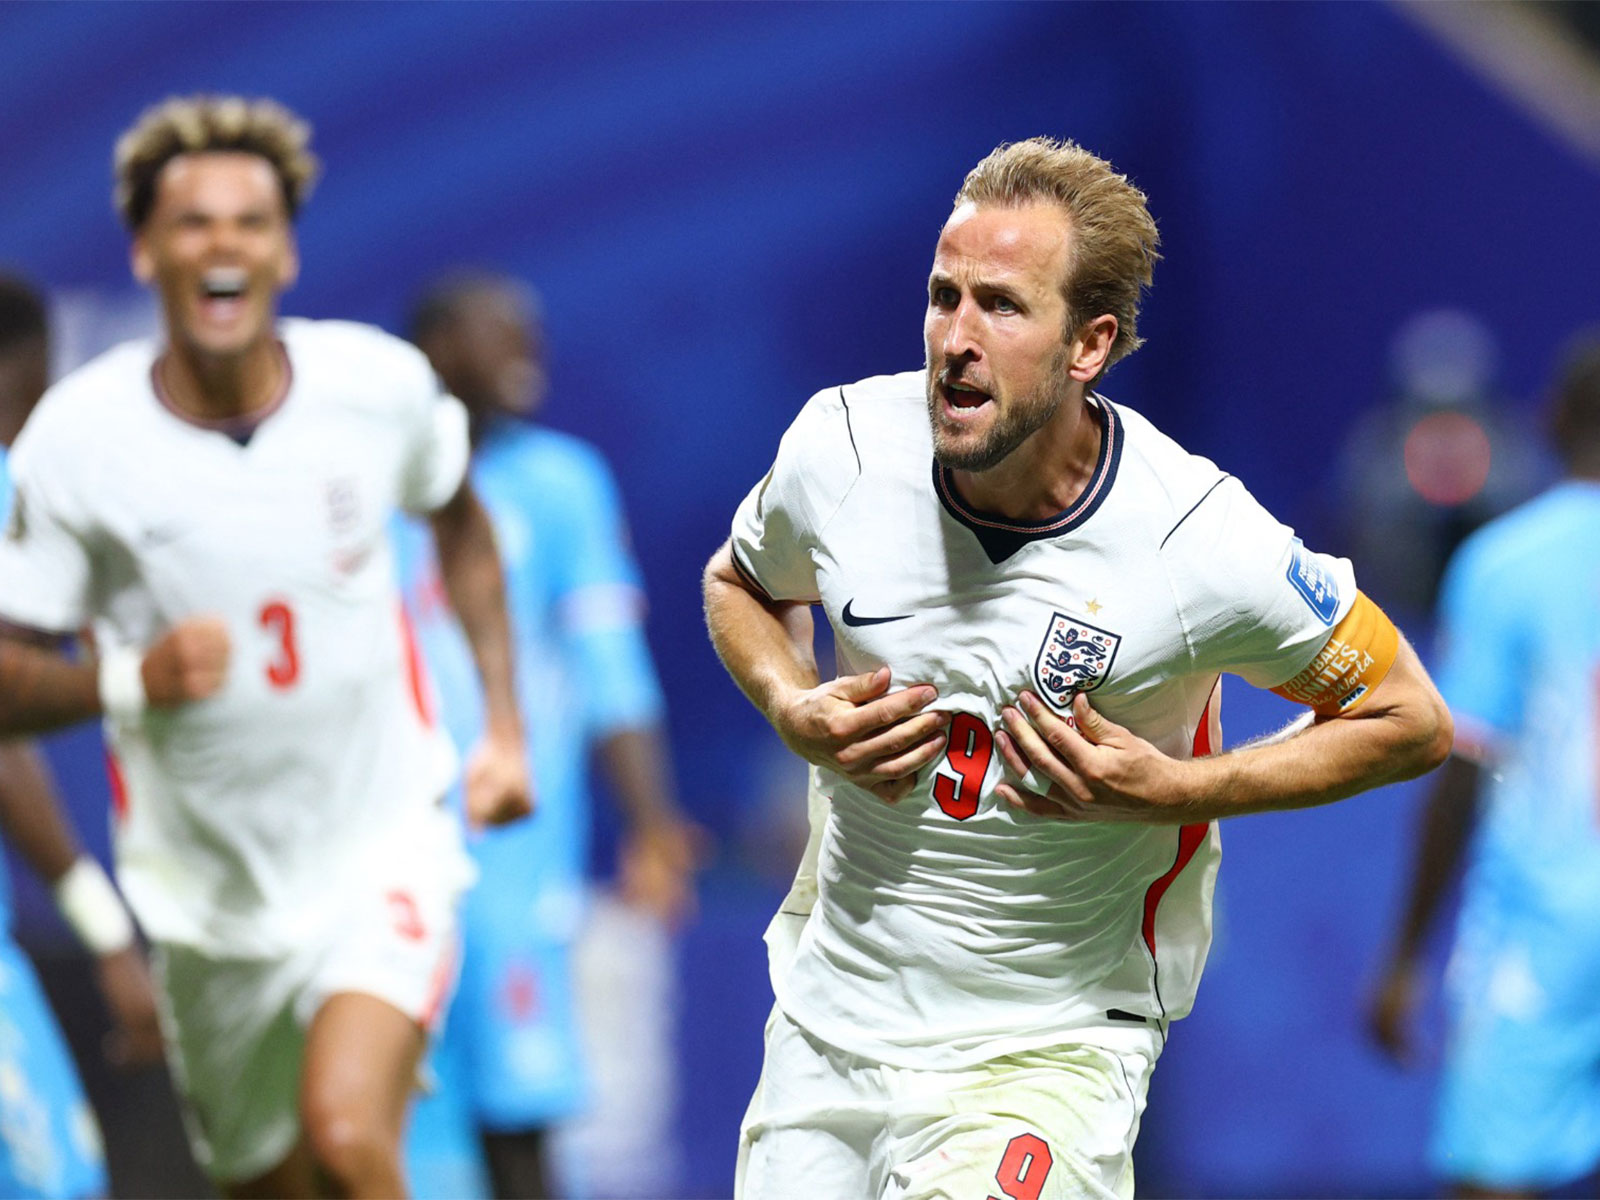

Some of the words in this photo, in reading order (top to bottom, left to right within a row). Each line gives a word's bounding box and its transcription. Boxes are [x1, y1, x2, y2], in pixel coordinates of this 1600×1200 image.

[257, 600, 299, 690] 3
[1283, 638, 1345, 695] FOOTBALL
[1292, 644, 1359, 702] UNITES
[1331, 650, 1375, 696] World
[932, 711, 994, 822] 9
[986, 1132, 1053, 1200] 9
